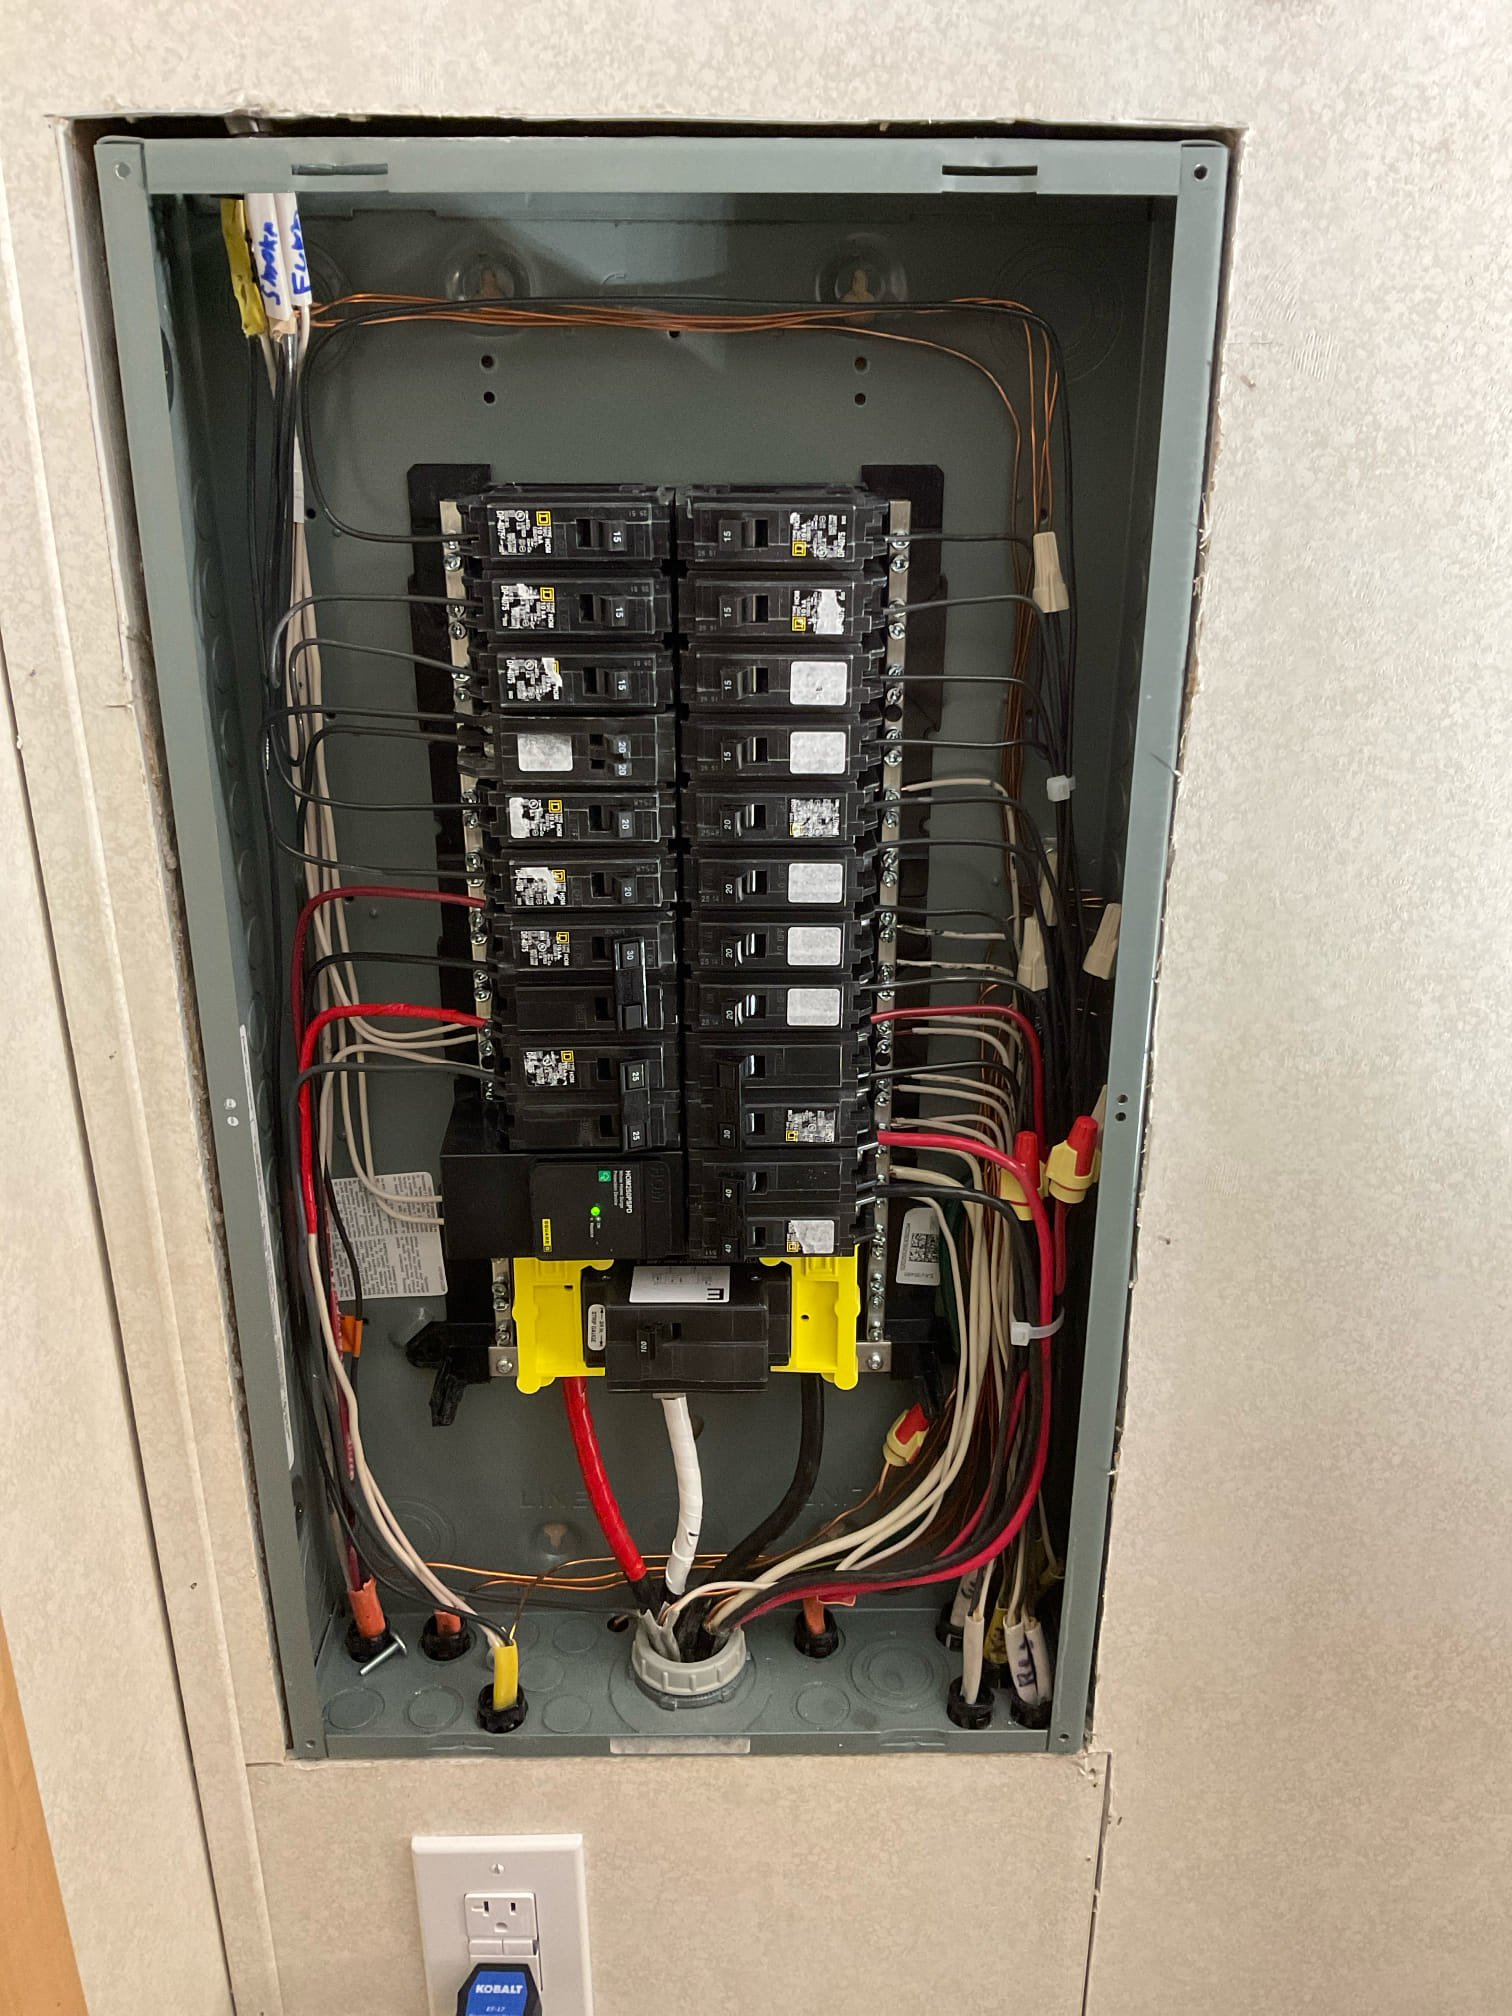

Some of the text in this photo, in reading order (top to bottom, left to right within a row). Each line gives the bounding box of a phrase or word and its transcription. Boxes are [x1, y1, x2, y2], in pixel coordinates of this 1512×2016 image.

[612, 530, 622, 544] 15
[724, 530, 732, 542] 15
[616, 607, 624, 618] 15
[724, 608, 732, 618] 15
[618, 679, 626, 691] 15
[724, 680, 732, 690] 15
[618, 741, 626, 753] 20
[724, 752, 732, 762] 15
[618, 764, 626, 776] 20
[622, 818, 630, 830] 20
[724, 818, 732, 830] 20
[624, 886, 632, 897] 20
[726, 884, 733, 894] 20
[626, 950, 634, 960] 30
[726, 948, 733, 958] 20
[726, 1010, 734, 1020] 20
[632, 1071, 640, 1082] 25
[632, 1130, 640, 1141] 25
[724, 1130, 731, 1139] 30
[725, 1188, 732, 1198] 40
[725, 1244, 732, 1254] 40
[640, 1340, 648, 1353] 100
[475, 1984, 523, 1994] KOBALT
